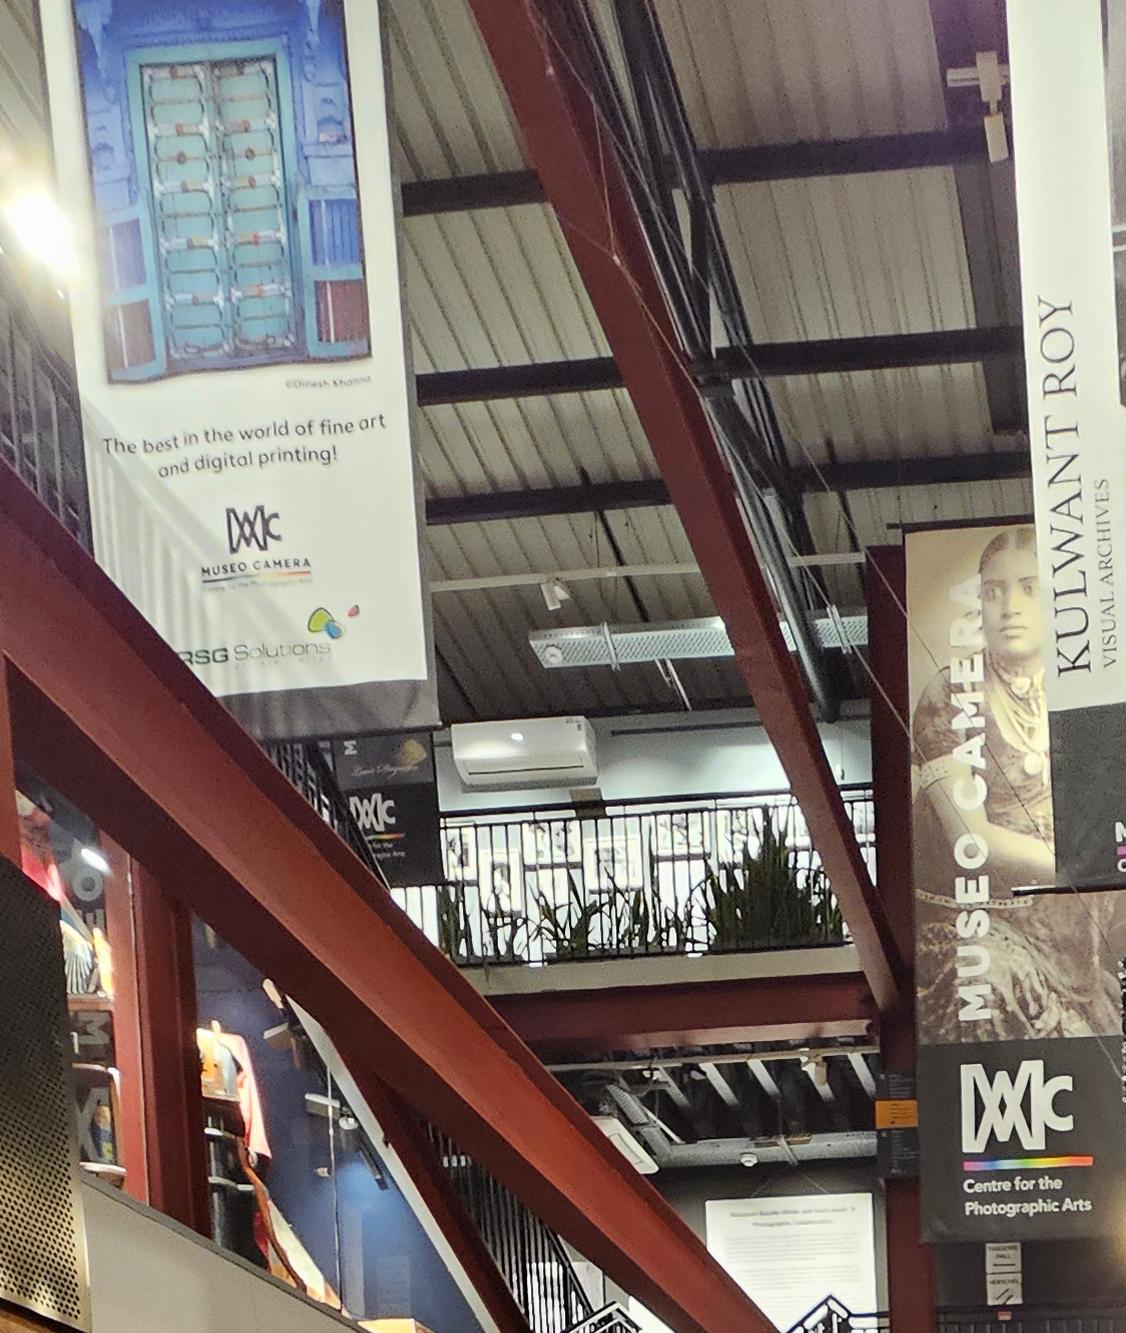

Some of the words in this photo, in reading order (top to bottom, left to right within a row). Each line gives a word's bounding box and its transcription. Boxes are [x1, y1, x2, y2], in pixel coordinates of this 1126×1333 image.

[1037, 294, 1078, 399] ROY
[103, 436, 138, 454] The
[143, 434, 180, 452] best
[183, 431, 199, 446] in
[205, 427, 234, 443] the
[239, 420, 289, 441] world
[295, 418, 315, 437] of
[320, 418, 354, 436] fine
[359, 413, 387, 430] art
[159, 457, 190, 478] and
[195, 448, 253, 474] digital
[258, 444, 338, 470] printing!
[1044, 414, 1092, 678] KULWANT
[1093, 478, 1114, 587] ARCHIVES
[201, 562, 247, 577] MUSEO
[253, 557, 312, 571] CAMERA
[234, 641, 332, 662] Solutions
[1099, 590, 1118, 670] VISUAL
[948, 573, 988, 811] CAMERA
[953, 833, 992, 1022] MUSEO
[963, 1178, 1012, 1194] Centre
[1014, 1176, 1036, 1191] for
[1038, 1175, 1063, 1190] the
[965, 1198, 1060, 1218] Photographic
[1061, 1197, 1093, 1212] Arts
